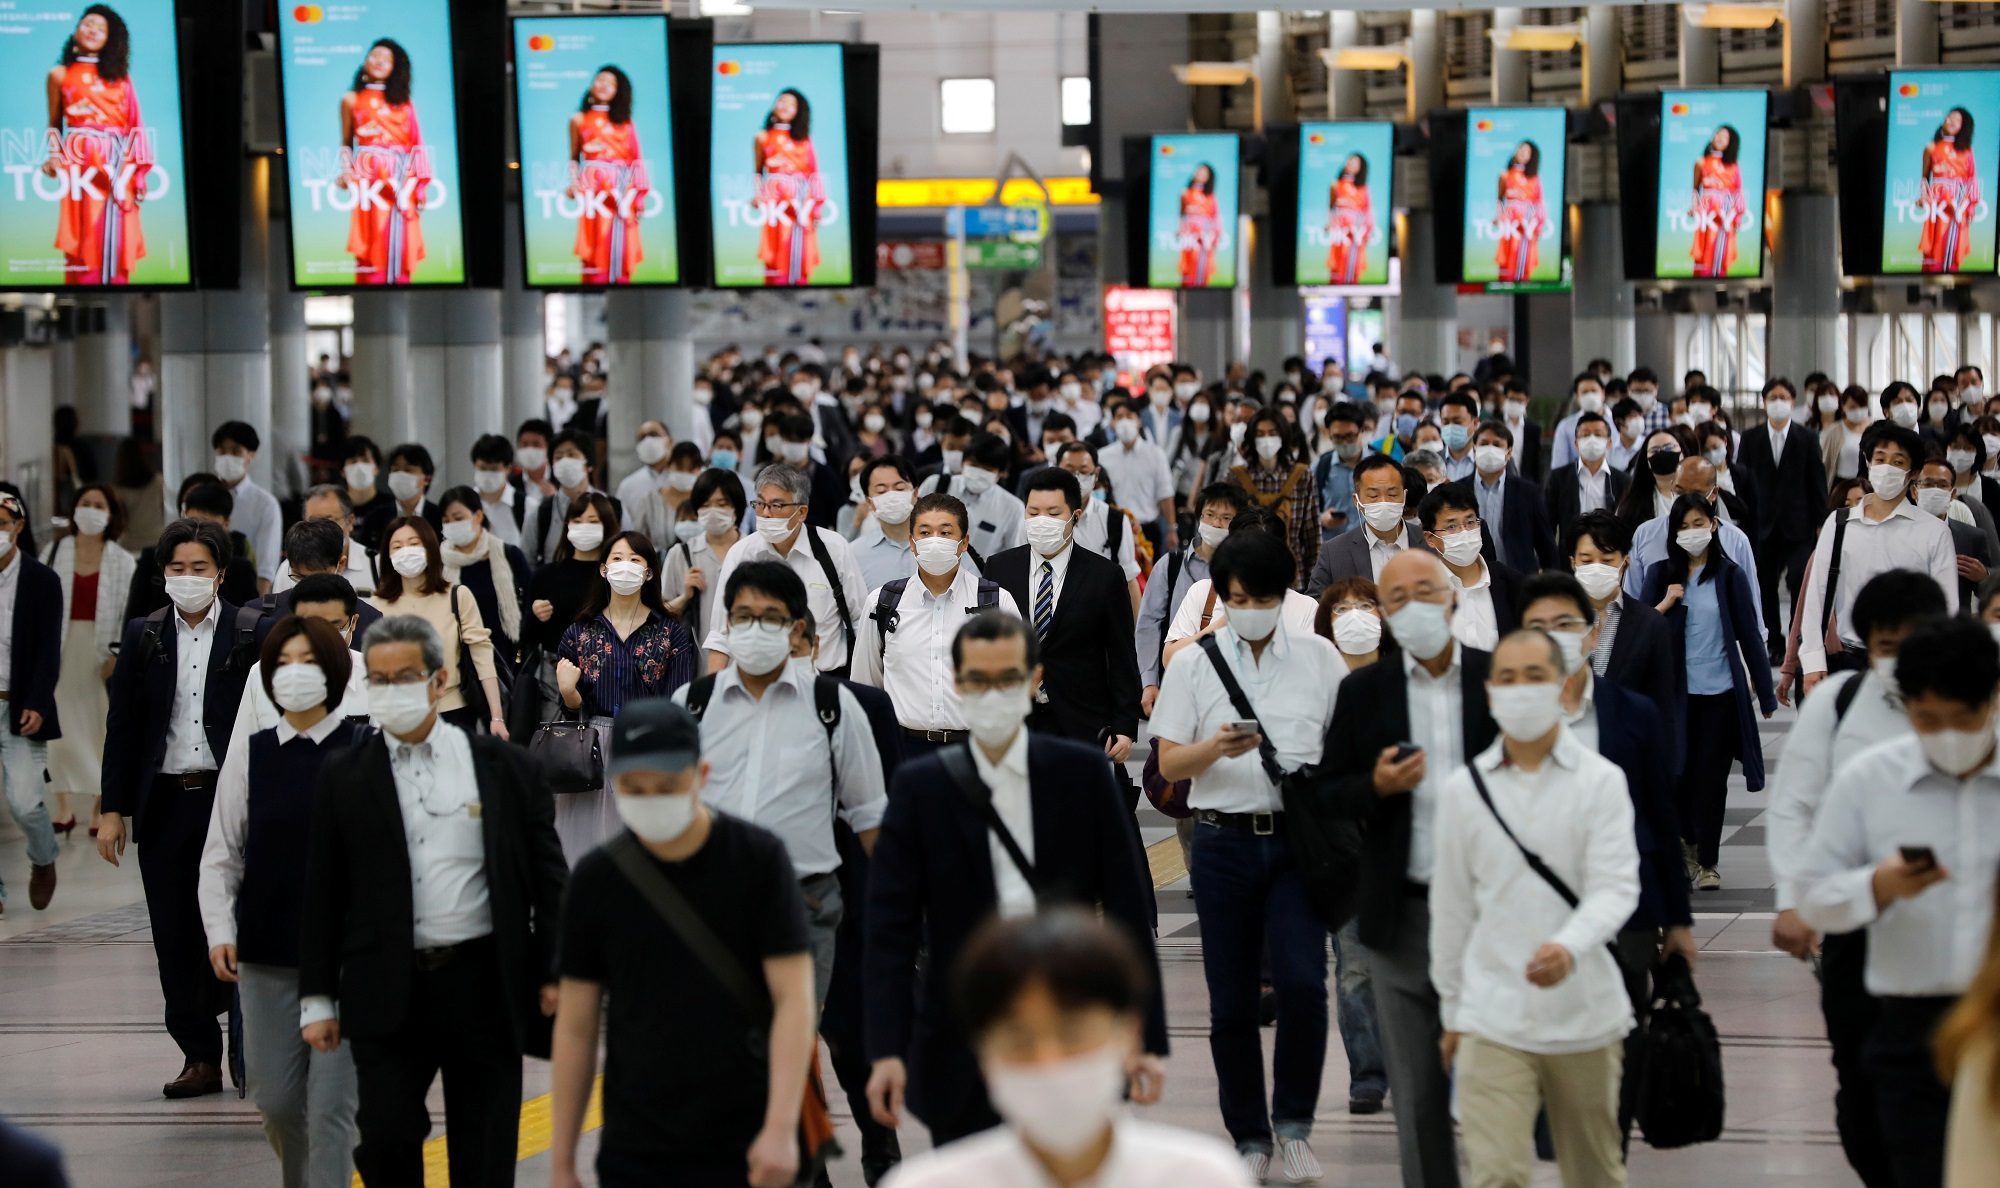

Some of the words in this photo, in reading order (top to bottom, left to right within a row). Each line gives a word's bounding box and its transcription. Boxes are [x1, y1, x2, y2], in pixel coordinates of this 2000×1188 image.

[1, 127, 157, 165] NAOMI
[301, 145, 437, 178] NAOMI
[3, 163, 170, 201] TOKYO
[302, 177, 448, 211] TOKYO
[533, 188, 664, 220] TOKYO
[722, 199, 839, 227] TOKYO
[1892, 199, 1988, 223] TOKYO
[1472, 218, 1555, 241] TOKYO
[1666, 208, 1754, 232] TOKYO
[1304, 224, 1383, 247] TOKYO
